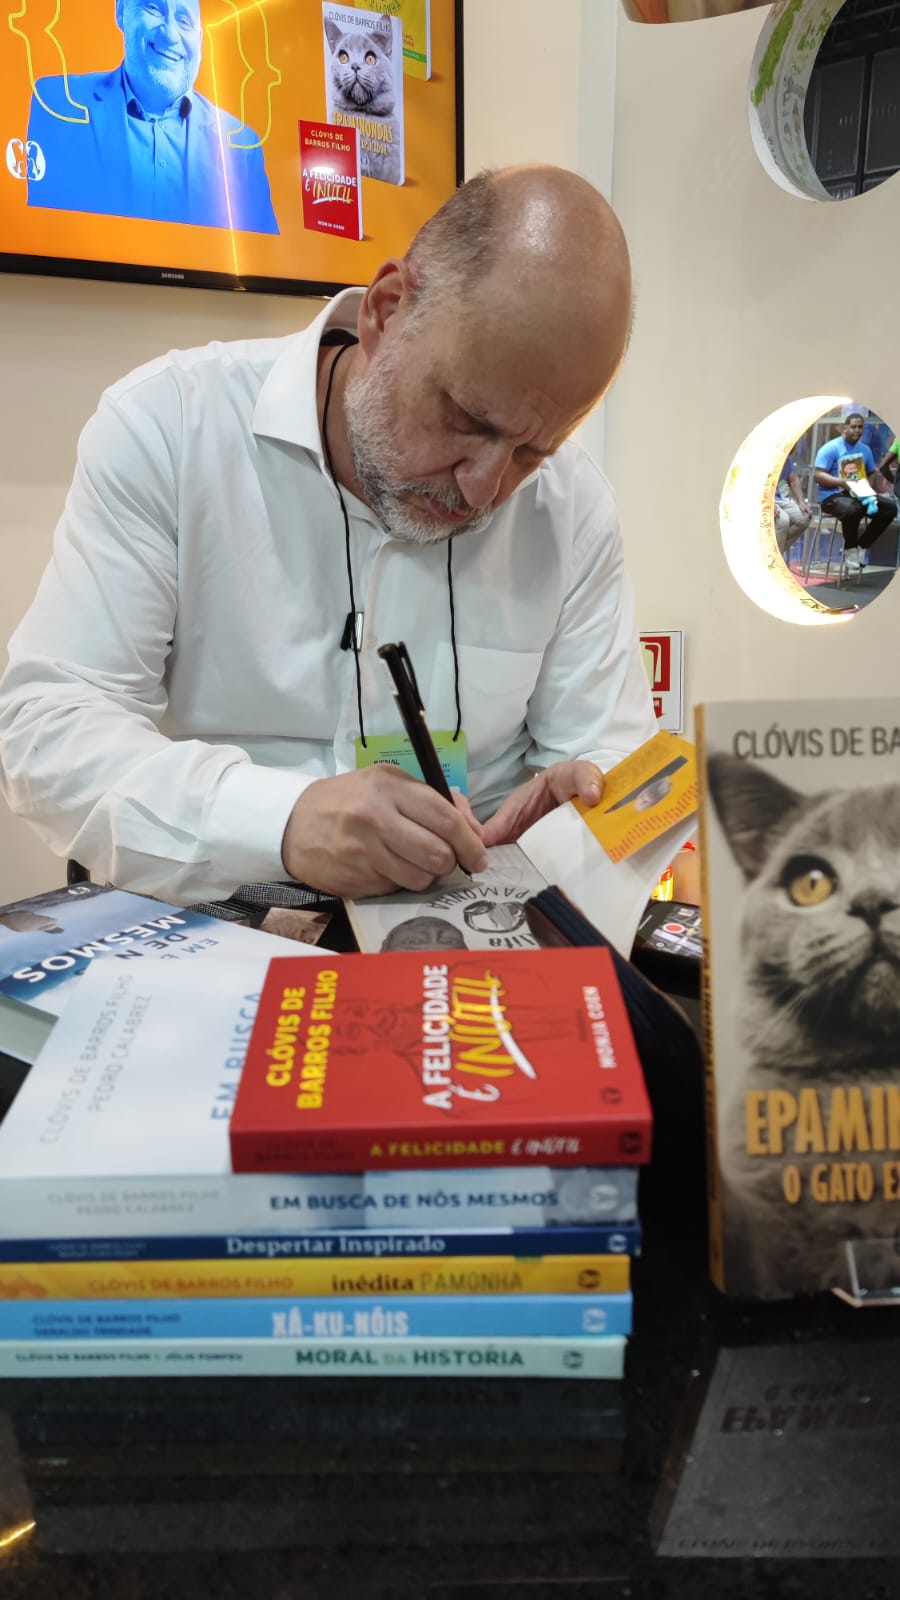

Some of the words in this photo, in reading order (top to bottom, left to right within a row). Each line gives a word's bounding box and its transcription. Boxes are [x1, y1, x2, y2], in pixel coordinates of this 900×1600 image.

[347, 15, 354, 24] DE
[356, 16, 376, 29] BARROS
[305, 138, 330, 149] BARROS
[332, 142, 351, 152] FILHO
[311, 130, 333, 140] CLÓVIS
[335, 134, 344, 142] DE
[310, 169, 358, 186] FELICIDADE
[733, 722, 825, 760] CLÓVIS
[830, 727, 864, 756] DE
[12, 915, 187, 984] MESMOS
[143, 933, 190, 950] DE
[422, 964, 452, 1086] FELICIDADE
[266, 1015, 300, 1087] CLÓVIS
[283, 986, 306, 1011] DE
[297, 1024, 331, 1109] BARROS
[317, 969, 339, 1021] FILHO
[422, 1089, 453, 1110] A
[370, 1144, 383, 1156] A
[389, 1140, 505, 1157] FELICIDADE
[784, 1165, 801, 1204] O
[811, 1162, 874, 1203] GATO
[270, 1195, 300, 1210] EM
[307, 1193, 377, 1209] BUSCA
[384, 1193, 409, 1208] DE
[417, 1189, 461, 1208] NÓS
[468, 1191, 559, 1207] MESMOS
[227, 1236, 333, 1257] Despertar
[339, 1235, 446, 1256] Inspirado
[150, 1279, 172, 1290] DE
[176, 1278, 242, 1290] BARROS
[245, 1277, 294, 1290] FILHO
[332, 1273, 415, 1292] inédita
[420, 1272, 524, 1291] PAMONHA
[272, 1306, 409, 1338] XÁ-KU-NÓIS
[296, 1350, 378, 1367] MORAL
[413, 1345, 525, 1367] HISTÓRIA
